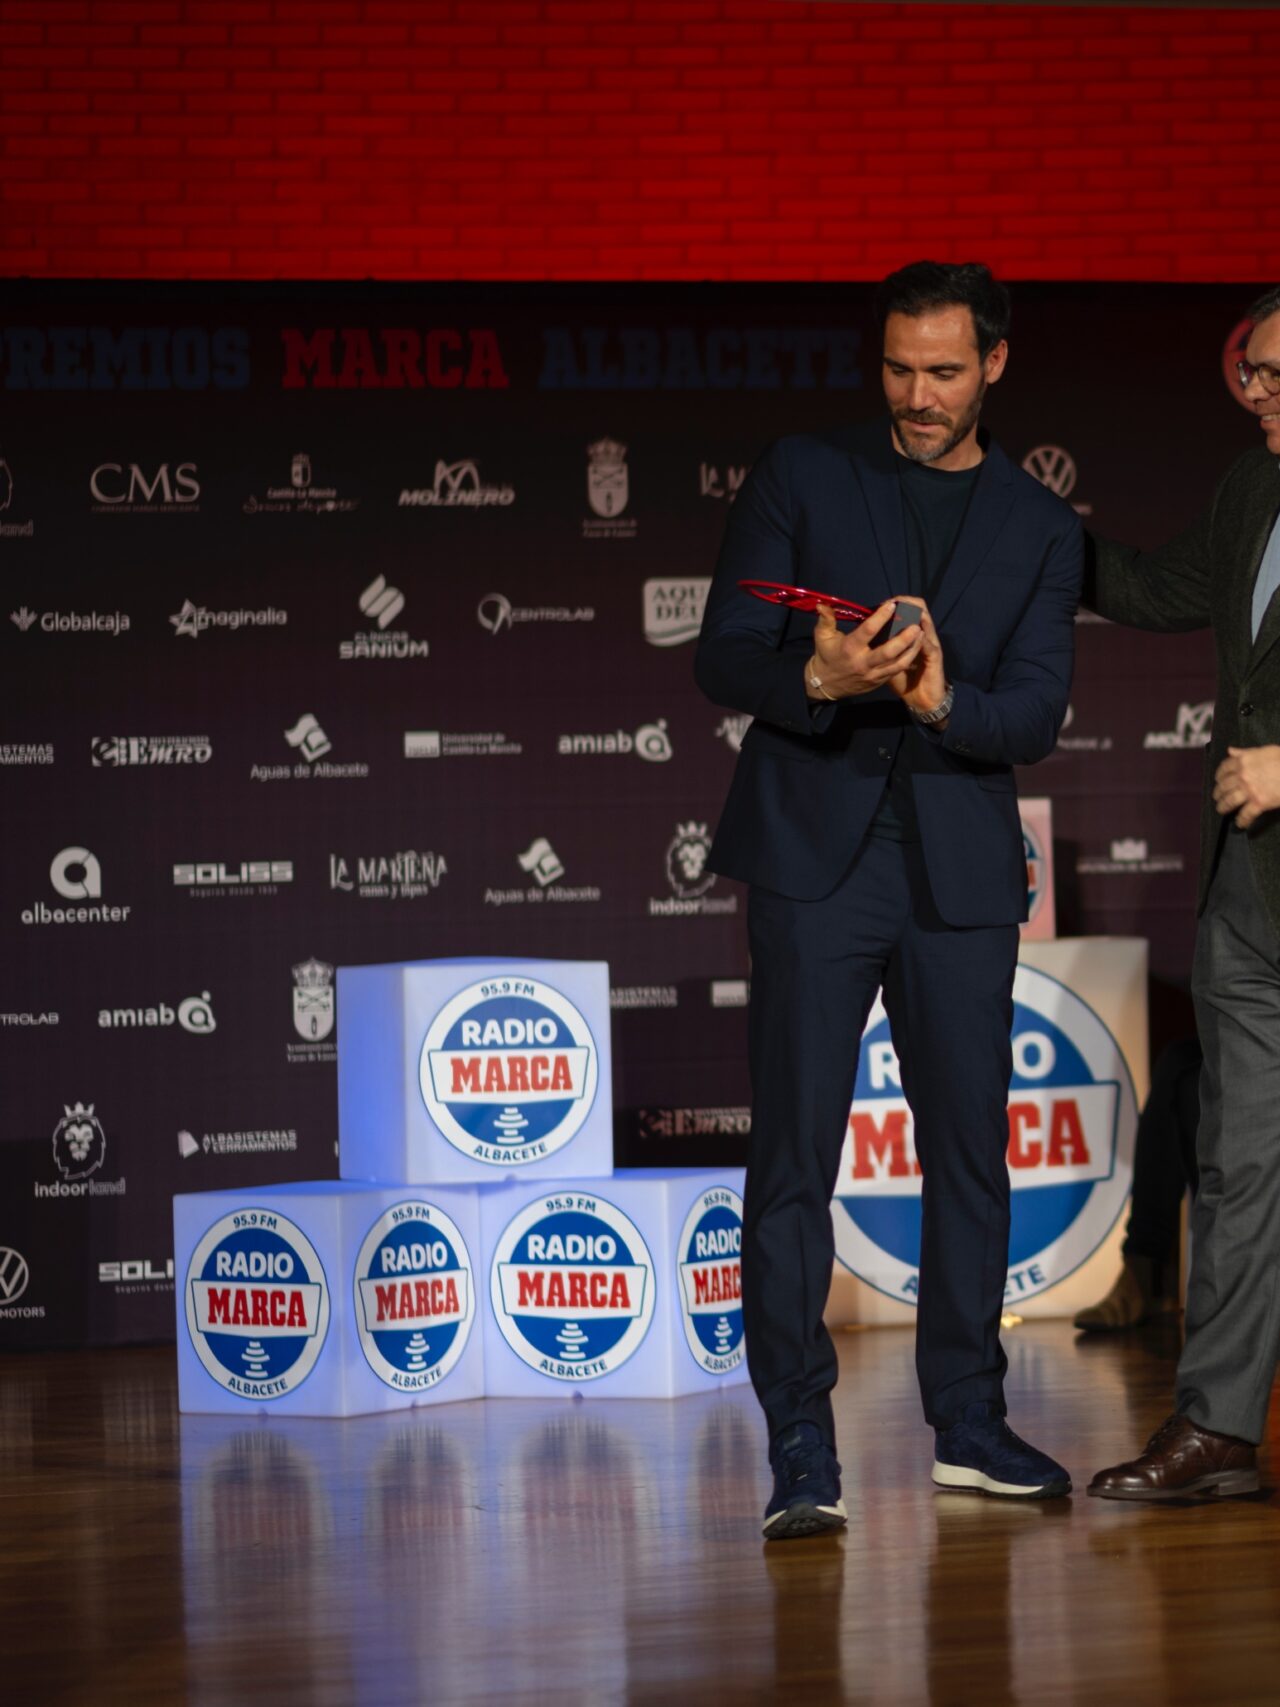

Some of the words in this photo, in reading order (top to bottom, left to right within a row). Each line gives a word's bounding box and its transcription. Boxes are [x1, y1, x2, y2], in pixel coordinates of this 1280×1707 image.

[0, 325, 251, 391] REMIOS
[281, 327, 510, 390] MARCA
[539, 327, 864, 391] ALBACETE
[89, 463, 201, 504] CMS
[653, 585, 706, 605] AQU
[41, 610, 131, 635] Globalcaja
[339, 640, 429, 659] SANIUM
[250, 763, 290, 782] Aguas
[294, 762, 310, 778] de
[314, 762, 369, 778] Albacete
[173, 861, 293, 885] SOLISS
[21, 902, 131, 924] albacenter
[0, 1012, 60, 1026] TROLAB
[461, 1017, 558, 1046] RADIO
[450, 1055, 573, 1093] MARCA
[473, 1142, 549, 1161] ALBACETE
[850, 1098, 1090, 1180] MCA
[527, 1234, 617, 1261] RADIO
[695, 1227, 742, 1258] RADIO
[216, 1250, 294, 1279] RADIO
[380, 1240, 448, 1273] RADIO
[99, 1259, 173, 1282] SOLI
[517, 1270, 631, 1308] MARCA
[692, 1264, 742, 1305] MARC
[207, 1287, 307, 1328] MARCA
[375, 1277, 460, 1322] MARCA
[391, 1367, 443, 1388] ALBACETE
[539, 1359, 607, 1377] ALBACETE
[228, 1377, 288, 1396] ALBACETE
